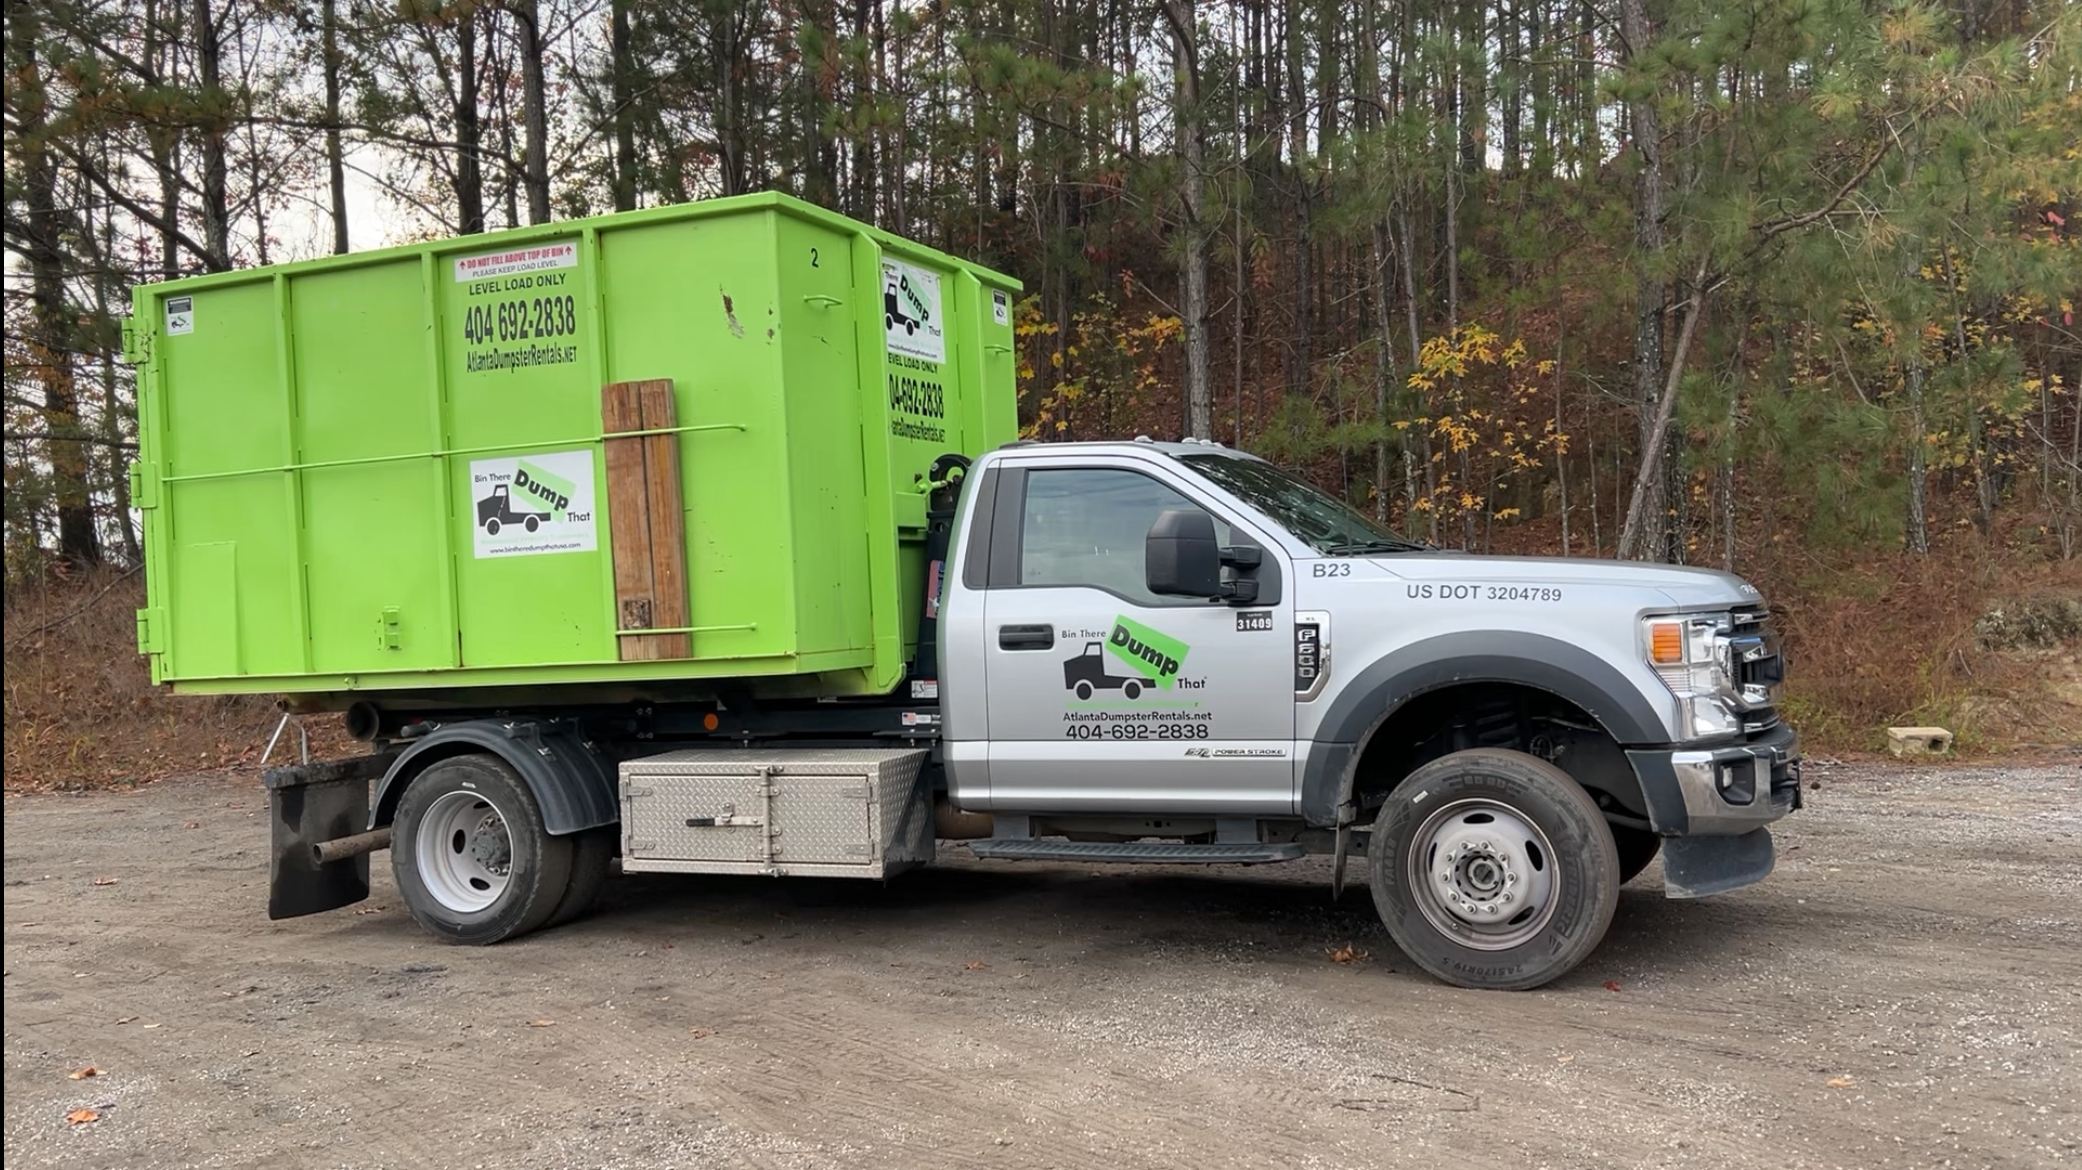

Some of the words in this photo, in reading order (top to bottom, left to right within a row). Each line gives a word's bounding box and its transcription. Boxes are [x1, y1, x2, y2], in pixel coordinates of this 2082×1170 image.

[467, 259, 477, 269] DO
[478, 256, 490, 268] NOT
[491, 255, 503, 266] FILL
[505, 252, 526, 264] ABOVE
[527, 250, 540, 262] TOP
[542, 249, 550, 259] OF
[552, 247, 564, 257] BIN
[811, 247, 819, 268] 2
[472, 268, 497, 278] PLEASE
[498, 265, 516, 275] KEEP
[517, 262, 536, 272] LOAD
[537, 260, 558, 270] LEVEL
[469, 280, 502, 296] LEVEL
[505, 277, 533, 291] LOAD
[536, 273, 567, 287] ONLY
[900, 273, 930, 322] Dump
[465, 304, 494, 345] 404
[498, 295, 576, 342] 692-2838
[467, 342, 577, 374] AtlantaDumpsterRentals.NET
[888, 352, 903, 367] EVEL
[903, 356, 920, 370] LOAD
[921, 361, 938, 374] ONLY
[889, 373, 944, 419] 04-692-2838
[474, 475, 487, 483] Bin
[489, 473, 511, 482] There
[514, 469, 569, 511] Dump
[567, 512, 590, 522] That
[1313, 563, 1351, 578] B23
[1406, 584, 1433, 599] US
[1440, 585, 1481, 600] DOT
[1487, 586, 1562, 602] 3204789
[1061, 630, 1076, 638] Bin
[1080, 629, 1106, 638] There
[1238, 618, 1271, 630] 31409
[1110, 624, 1179, 677] Dump
[1177, 678, 1206, 689] That
[1063, 710, 1212, 723] AtlantaDumpsterRentals.net
[1066, 724, 1209, 740] 404-692-2838
